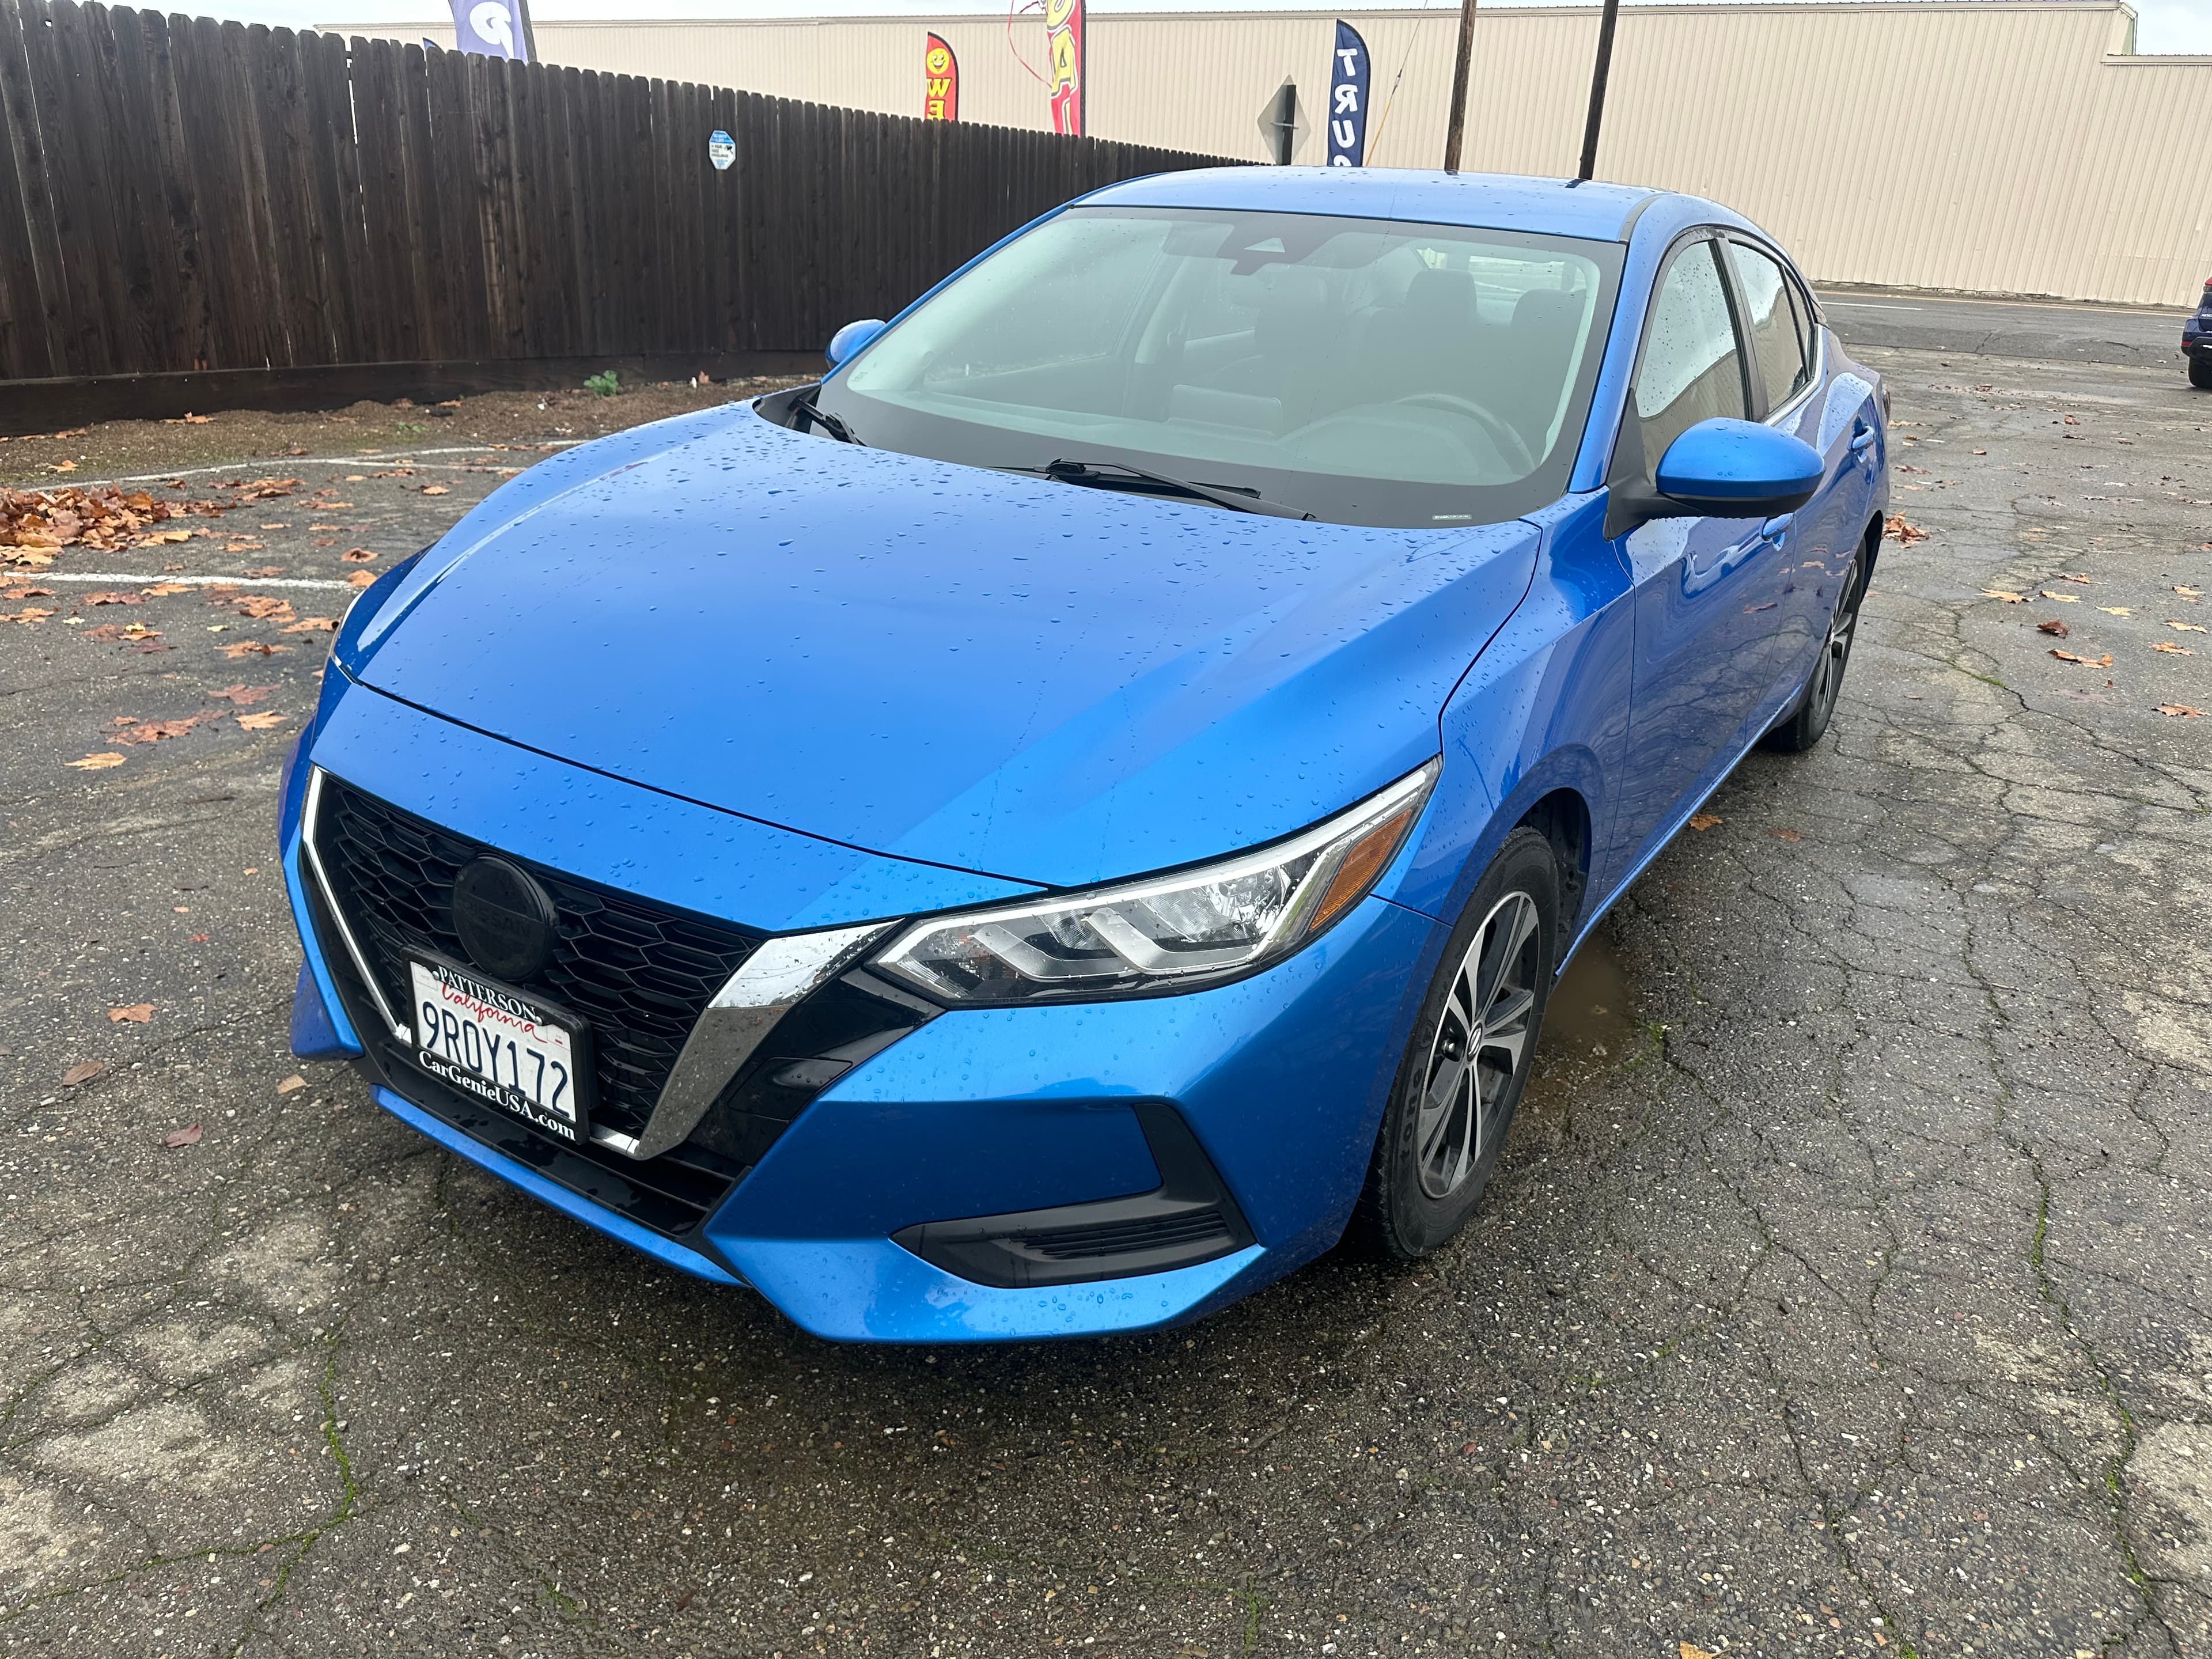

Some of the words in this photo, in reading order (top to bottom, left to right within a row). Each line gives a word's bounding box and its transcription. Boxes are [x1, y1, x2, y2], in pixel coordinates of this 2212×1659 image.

[438, 965, 536, 1021] PATTERSON
[442, 983, 548, 1043] California
[419, 1051, 575, 1141] CarGenieUSA.com
